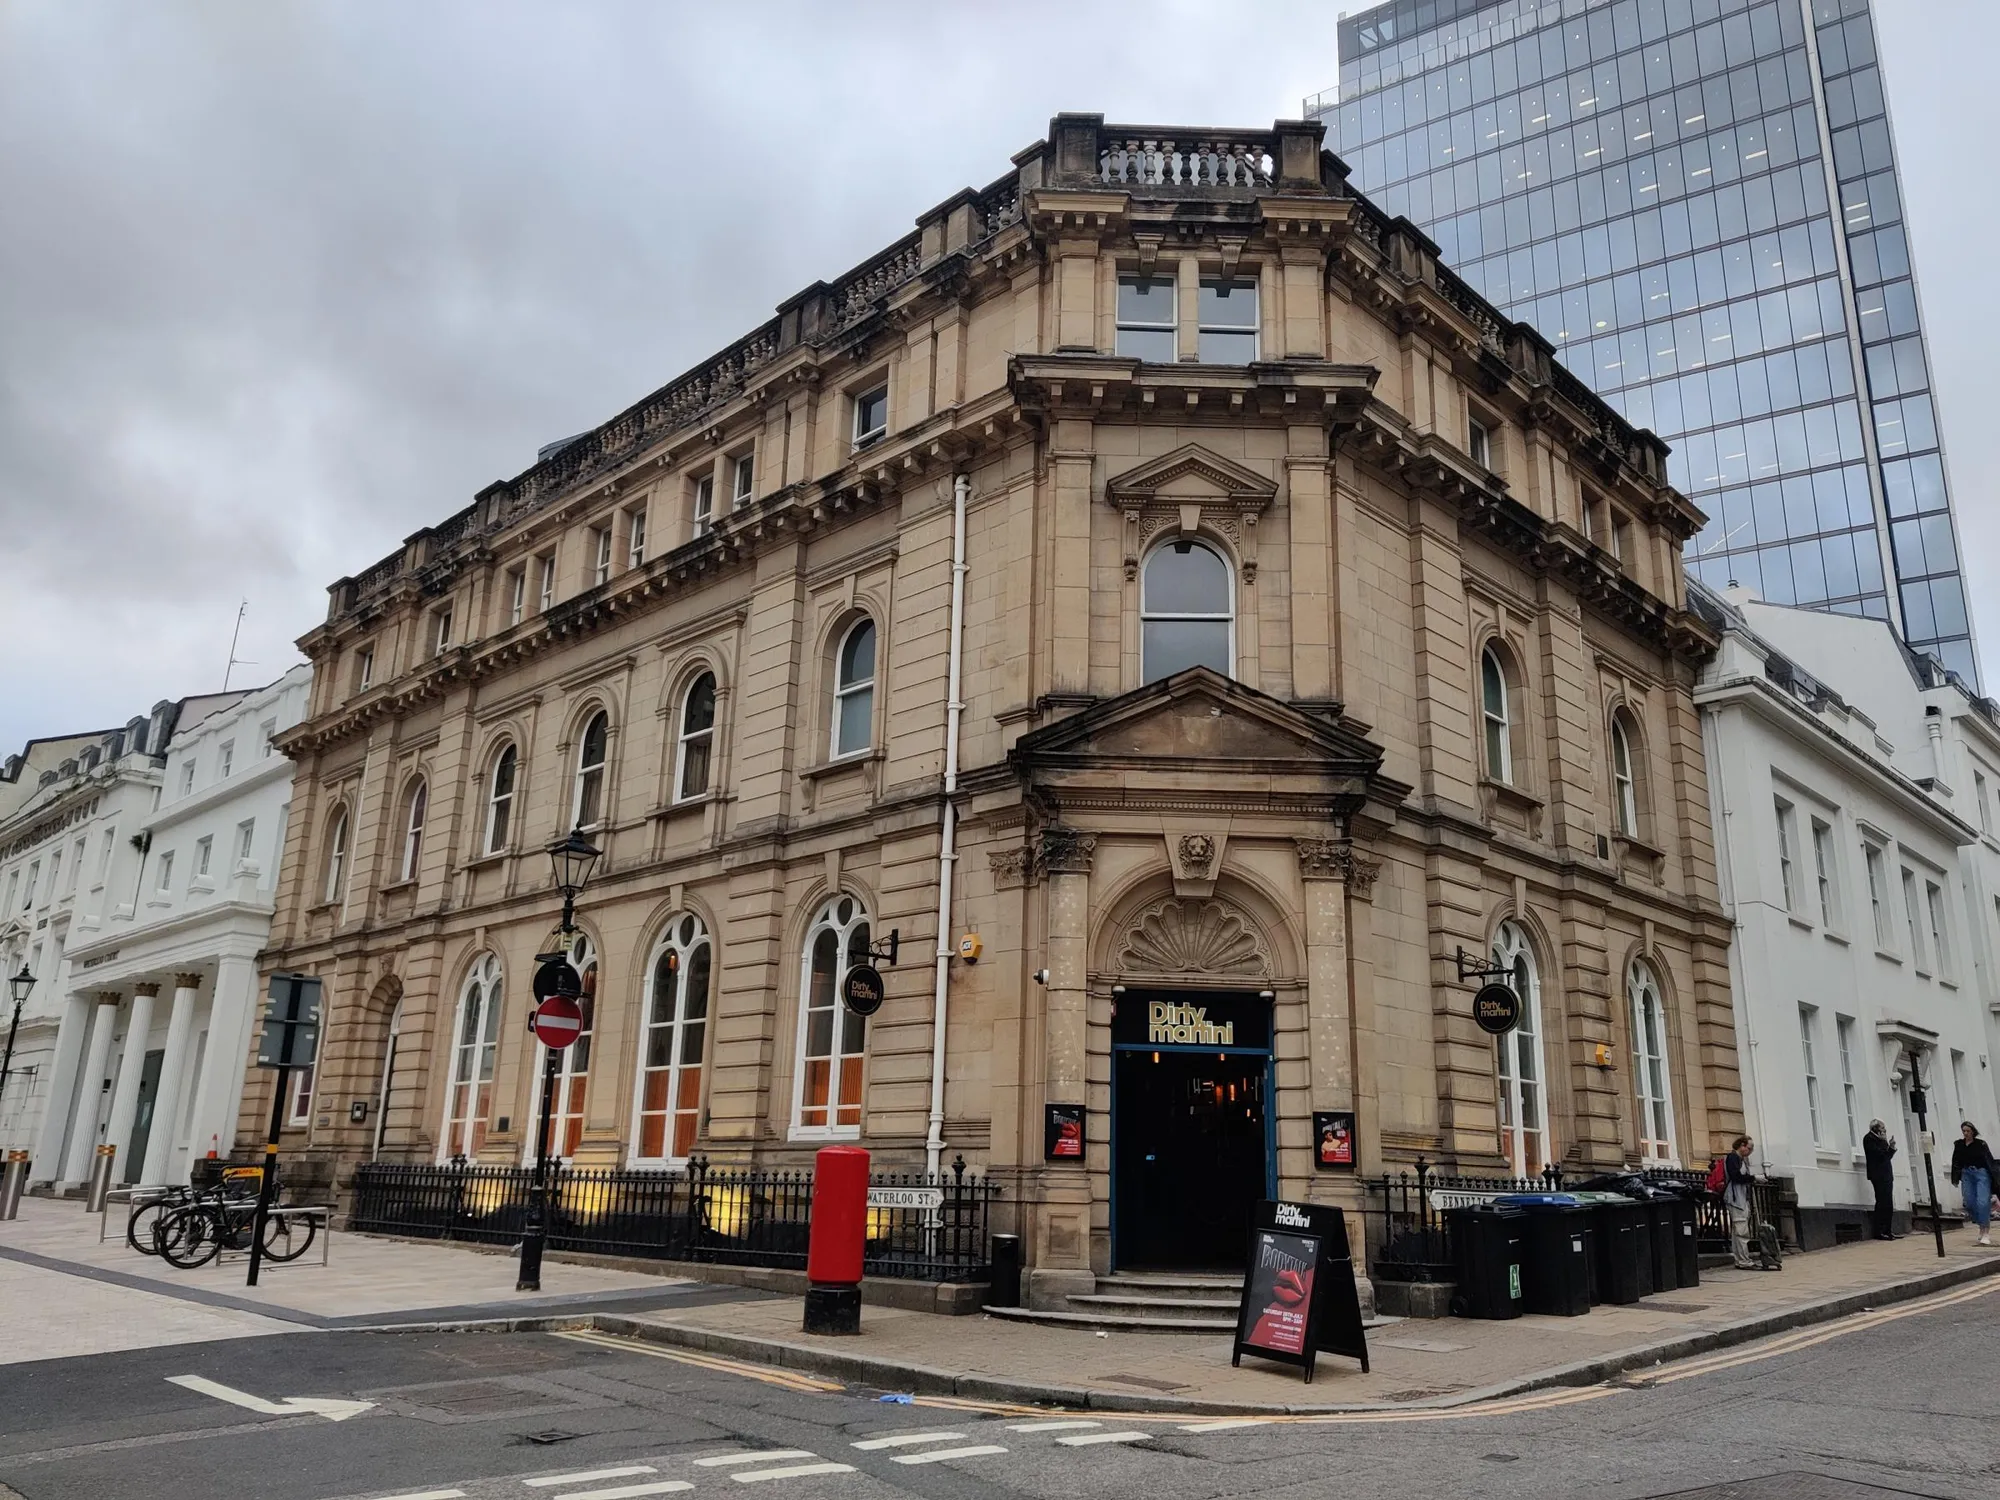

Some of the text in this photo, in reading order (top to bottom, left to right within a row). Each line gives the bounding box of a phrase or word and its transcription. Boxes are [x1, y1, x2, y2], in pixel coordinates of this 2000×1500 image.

[851, 980, 870, 991] Dirty
[851, 988, 878, 1000] martini
[1480, 1001, 1501, 1011] Dirty
[1480, 1007, 1511, 1017] martini
[1149, 1001, 1207, 1028] Dirty
[1149, 1021, 1234, 1044] martini
[918, 1193, 930, 1205] ST
[1276, 1203, 1301, 1217] Dirty
[1275, 1213, 1311, 1228] martini
